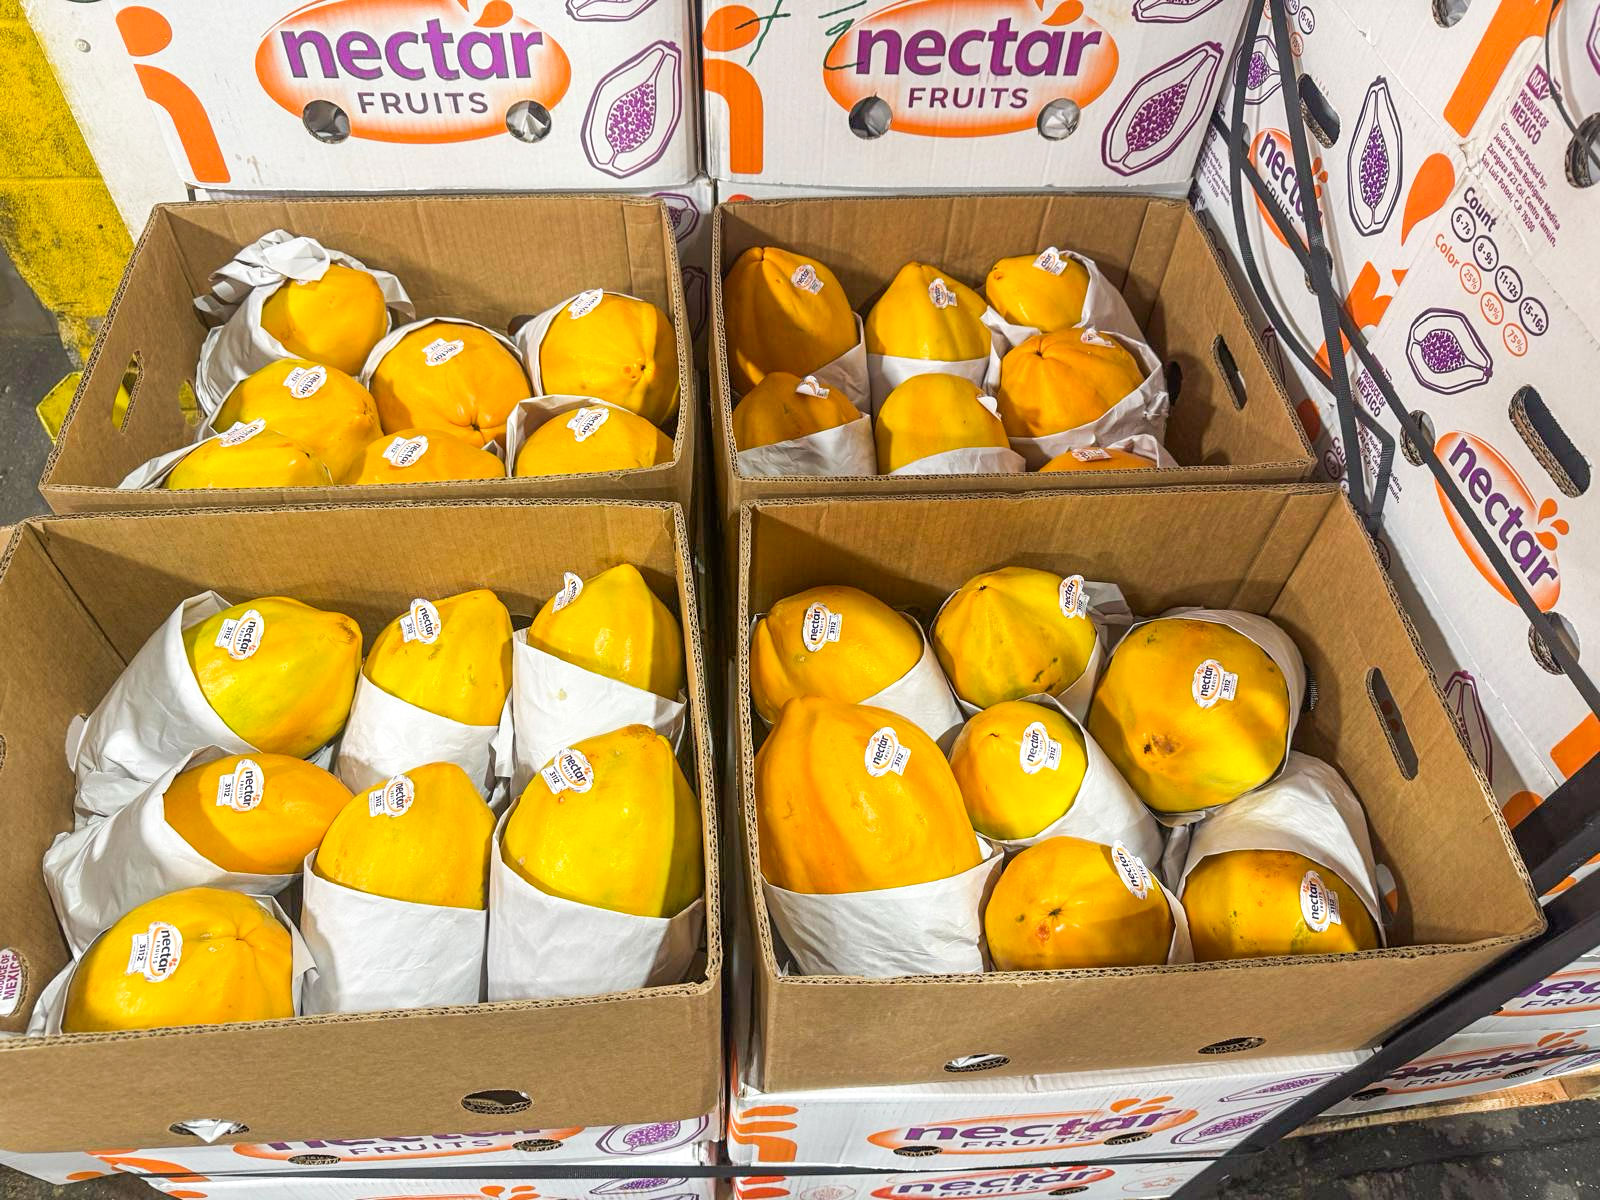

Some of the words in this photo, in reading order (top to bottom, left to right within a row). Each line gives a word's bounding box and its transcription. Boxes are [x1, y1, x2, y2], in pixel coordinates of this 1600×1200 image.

[280, 18, 544, 82] nectar
[856, 18, 1102, 77] nectar
[357, 91, 489, 114] FRUITS
[908, 86, 1028, 109] FRUITS
[1518, 88, 1543, 123] PRODUCE
[1539, 116, 1549, 130] OF
[1510, 101, 1541, 145] MEXICO
[1487, 142, 1508, 174] Zaragoza
[1524, 195, 1540, 220] Centro
[1463, 186, 1498, 233] Count
[1434, 233, 1461, 270] Color
[1463, 268, 1480, 290] 25%
[1498, 271, 1519, 299] 11-12s
[1484, 298, 1501, 321] 50%
[1522, 302, 1545, 333] 15-16s
[1507, 330, 1524, 353] 75%
[300, 374, 320, 395] nectar
[1355, 376, 1381, 418] MEXICO
[1360, 368, 1381, 401] PRODUCE
[582, 413, 602, 435] nectar
[400, 443, 421, 465] nectar
[1449, 438, 1559, 586] nectar
[1064, 580, 1076, 609] nectar
[420, 607, 434, 636] nectar
[810, 609, 820, 641] nectar
[239, 621, 257, 654] nectar
[1200, 666, 1213, 697] nectar
[873, 735, 888, 765] nectar
[1026, 730, 1039, 762] nectar
[549, 771, 559, 785] 3112
[564, 754, 587, 782] nectar
[223, 783, 231, 798] 3112
[243, 770, 254, 806] nectar
[395, 782, 404, 809] nectar
[1117, 849, 1140, 887] nectar
[1309, 880, 1319, 920] nectar
[137, 943, 146, 961] 3112
[158, 929, 171, 973] nectar
[1404, 1068, 1505, 1088] FRUITS
[904, 1109, 1182, 1141] nectar
[349, 1138, 493, 1155] FRUITS
[961, 1134, 1096, 1149] FRUITS
[898, 1168, 1099, 1194] nectar
[939, 1184, 1041, 1198] FRUITS
